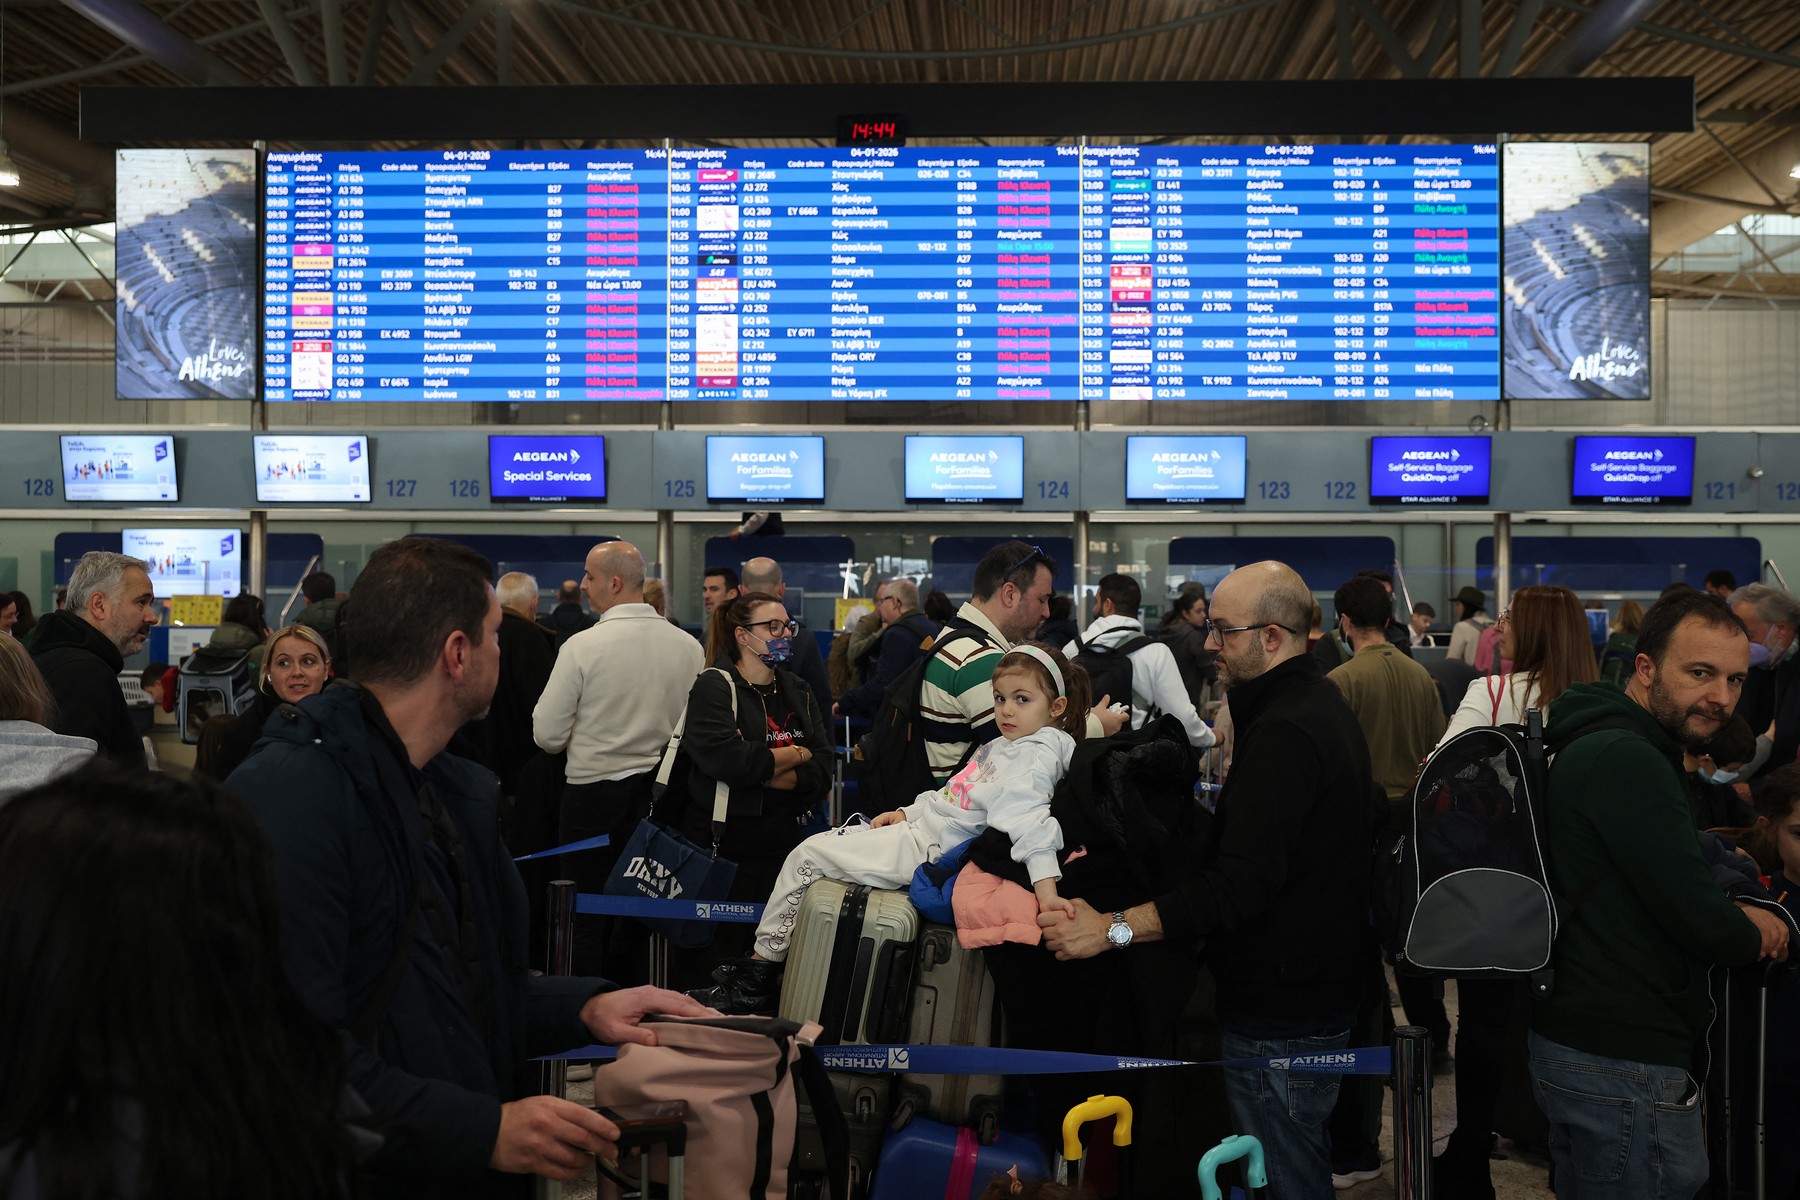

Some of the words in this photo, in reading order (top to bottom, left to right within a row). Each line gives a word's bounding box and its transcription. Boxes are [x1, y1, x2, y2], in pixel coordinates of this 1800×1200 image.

[852, 123, 895, 139] 14:44
[645, 150, 666, 159] 14:44
[671, 149, 726, 159] Αναχωρήσεις
[851, 148, 898, 157] 04-01-2026
[1056, 147, 1079, 156] 14:44
[1083, 146, 1139, 157] Αναχωρήσεις
[1265, 146, 1314, 155] 04-01-2026
[1473, 145, 1496, 154] 14:44
[267, 152, 322, 163] Αναχωρήσεις
[444, 151, 490, 160] 04-01-2026
[1216, 169, 1232, 177] 3311
[548, 185, 561, 193] B27
[744, 208, 755, 216] GQ
[788, 208, 798, 216] EY
[547, 257, 560, 265] C15
[744, 256, 752, 264] E2
[755, 256, 767, 264] 702
[957, 255, 971, 263] A27
[382, 282, 393, 290] HO
[395, 282, 411, 290] 3319
[587, 281, 601, 289] Νέα
[758, 280, 776, 288] 4394
[352, 306, 367, 314] 7512
[458, 306, 472, 314] TLV
[1202, 303, 1212, 311] A3
[1214, 303, 1231, 311] 7074
[381, 330, 391, 338] EK
[392, 330, 410, 338] 4952
[456, 354, 472, 362] LGW
[546, 354, 560, 362] A24
[337, 379, 348, 387] GQ
[381, 379, 390, 387] EY
[547, 378, 559, 386] B17
[743, 378, 754, 386] QR
[957, 377, 971, 385] A22
[513, 452, 568, 462] AEGEAN
[731, 453, 786, 463] AEGEAN
[930, 453, 985, 463] AEGEAN
[1152, 453, 1208, 463] AEGEAN
[1402, 451, 1449, 460] AEGEAN
[1605, 451, 1653, 460] AEGEAN
[737, 465, 792, 475] ForFamilies
[936, 465, 990, 475] ForFamilies
[1157, 465, 1213, 475] ForFamilies
[1388, 463, 1435, 472] Self-Service
[1436, 463, 1474, 474] Baggage
[1590, 463, 1638, 472] Self-Service
[1638, 463, 1677, 474] Baggage
[503, 470, 544, 483] Special
[546, 470, 592, 482] Services
[1401, 473, 1447, 483] QuickDrop
[1447, 473, 1460, 481] off
[1603, 473, 1650, 483] QuickDrop
[1650, 473, 1663, 482] off
[23, 478, 54, 497] 128
[386, 479, 417, 497] 127
[449, 479, 480, 498] 126
[664, 479, 696, 498] 125
[1038, 480, 1070, 499] 124
[1258, 481, 1291, 499] 123
[1324, 481, 1356, 499] 122
[1704, 481, 1735, 499] 121
[772, 730, 792, 741] Klein
[623, 856, 683, 899] DKNY
[637, 882, 647, 893] NEW
[711, 903, 755, 914] ATHENS
[823, 1057, 886, 1069] ATHENS
[1292, 1053, 1356, 1064] ATHENS
